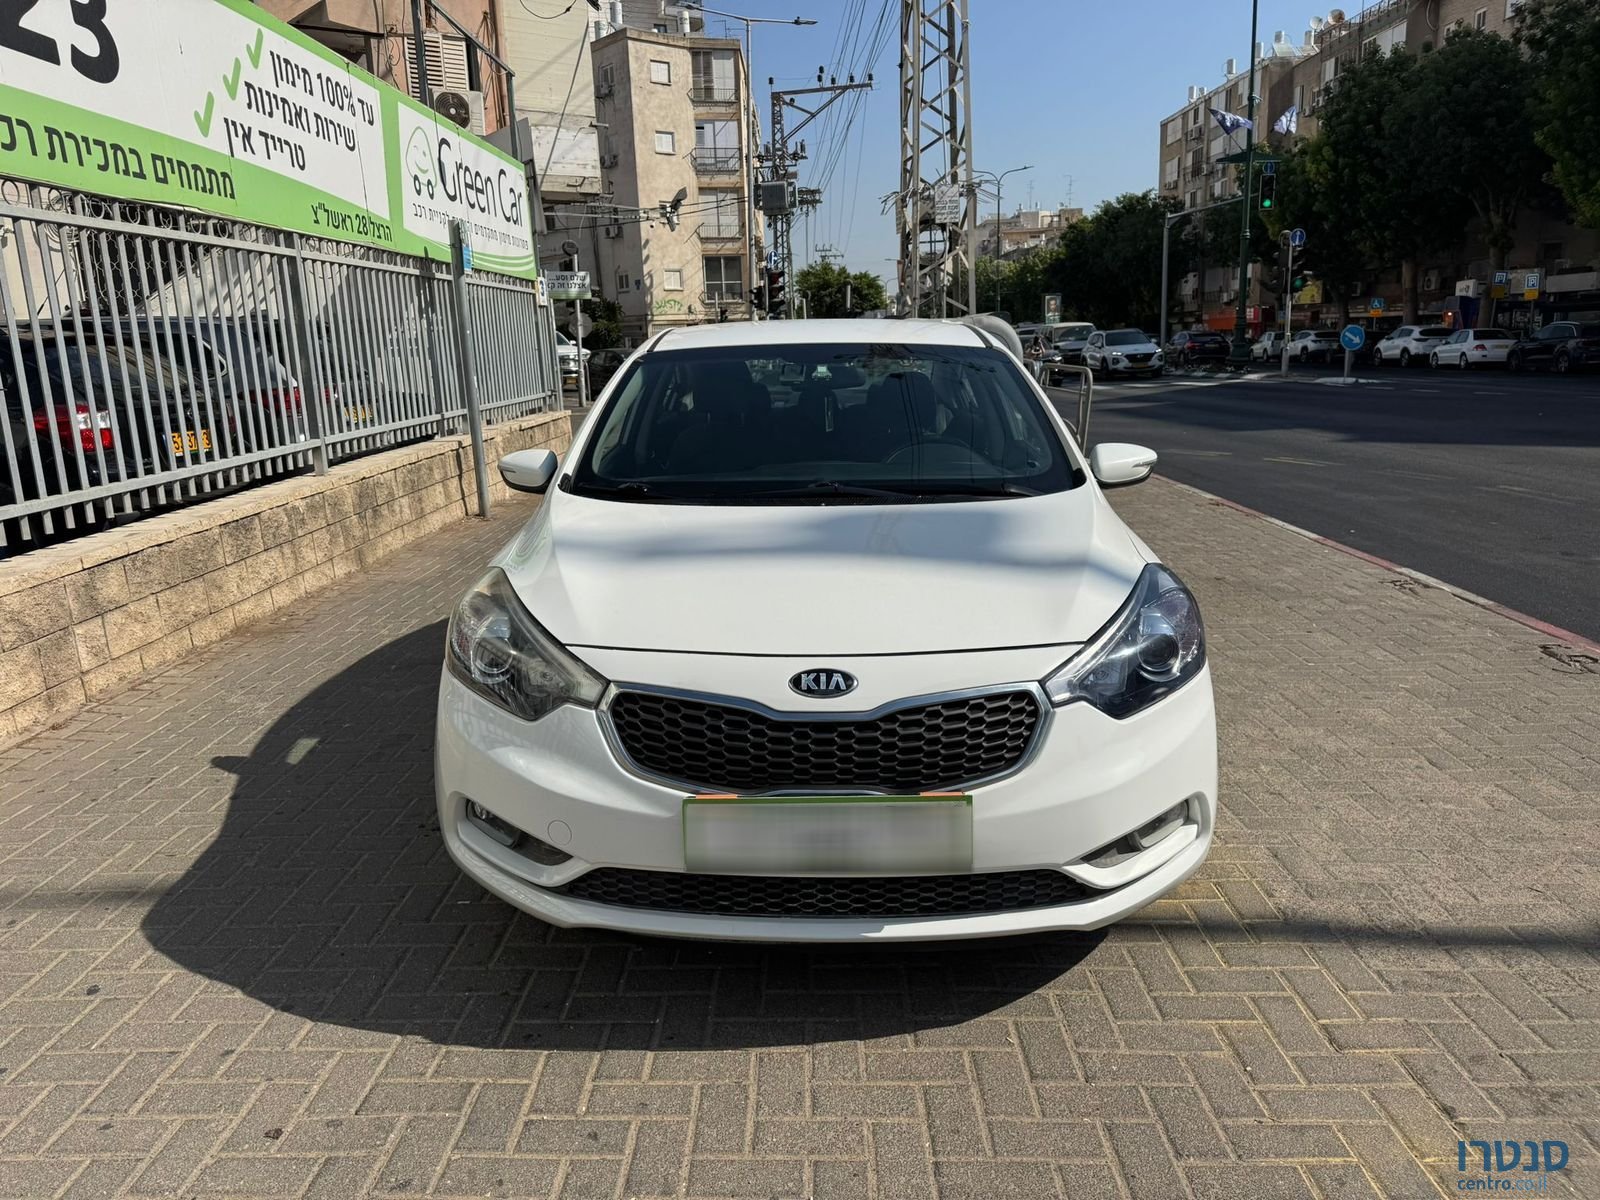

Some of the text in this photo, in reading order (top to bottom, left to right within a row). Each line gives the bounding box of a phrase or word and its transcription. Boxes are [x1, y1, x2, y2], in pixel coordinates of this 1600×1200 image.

[270, 50, 374, 126] עד 100% מימון
[244, 80, 356, 152] שירות ואמינות
[44, 125, 147, 180] במכירת
[223, 117, 306, 171] טרייד אין
[151, 153, 235, 200] מתמחים
[438, 137, 522, 227] Green Car
[355, 214, 368, 236] 28
[369, 216, 392, 242] הרצל
[412, 202, 427, 219] רכב
[801, 672, 847, 690] KIA
